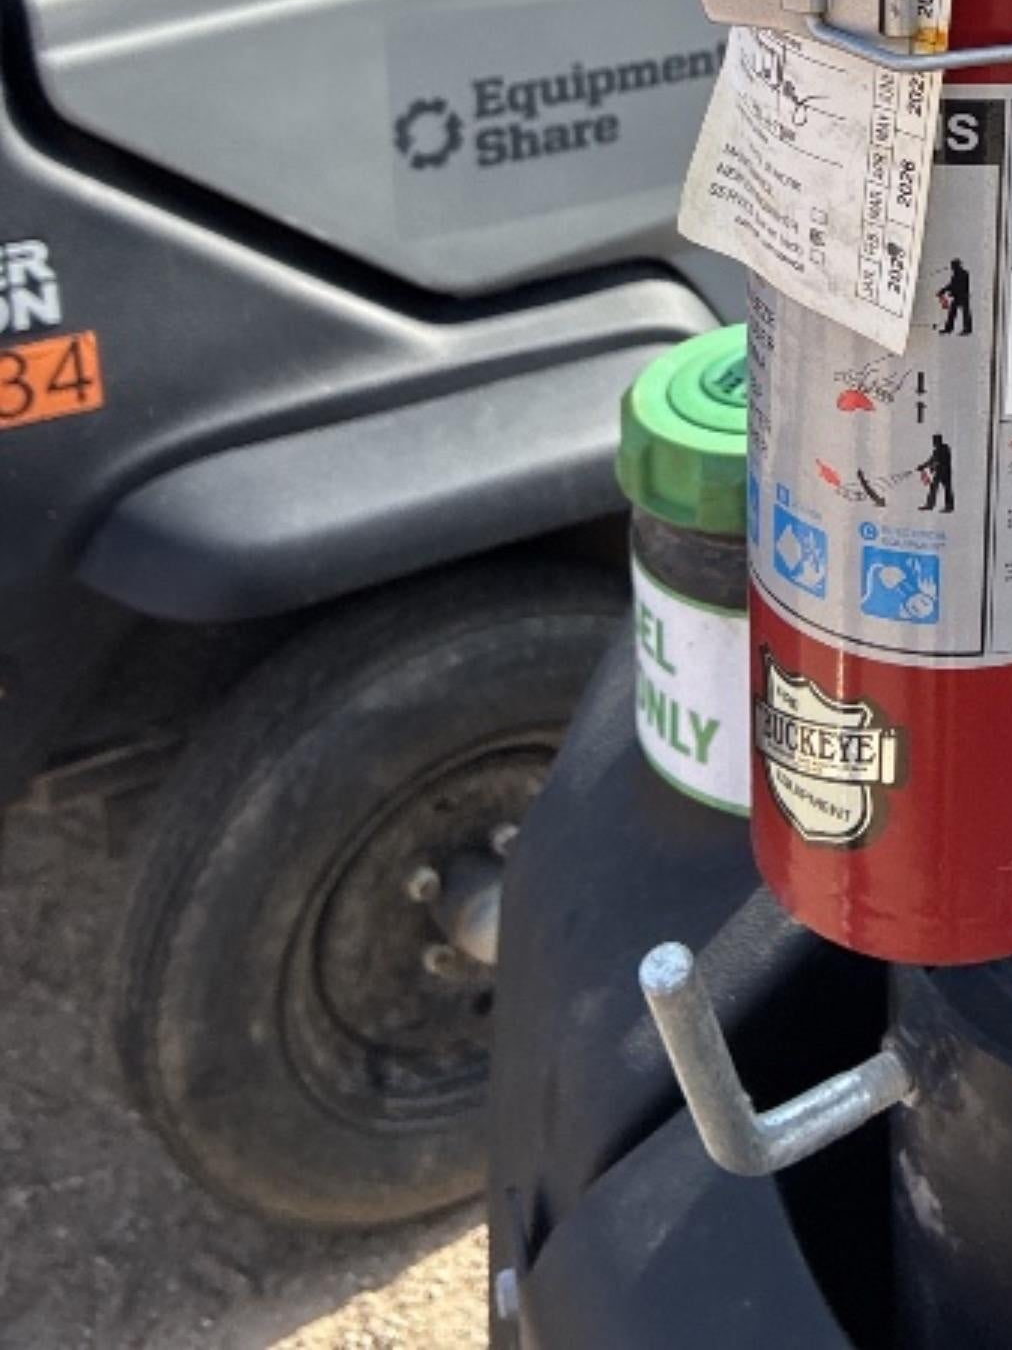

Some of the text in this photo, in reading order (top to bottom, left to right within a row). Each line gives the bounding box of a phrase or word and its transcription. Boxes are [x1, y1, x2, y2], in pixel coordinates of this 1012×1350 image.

[474, 112, 621, 168] Share
[946, 113, 980, 151] S
[0, 240, 58, 290] R
[637, 603, 677, 677] EL
